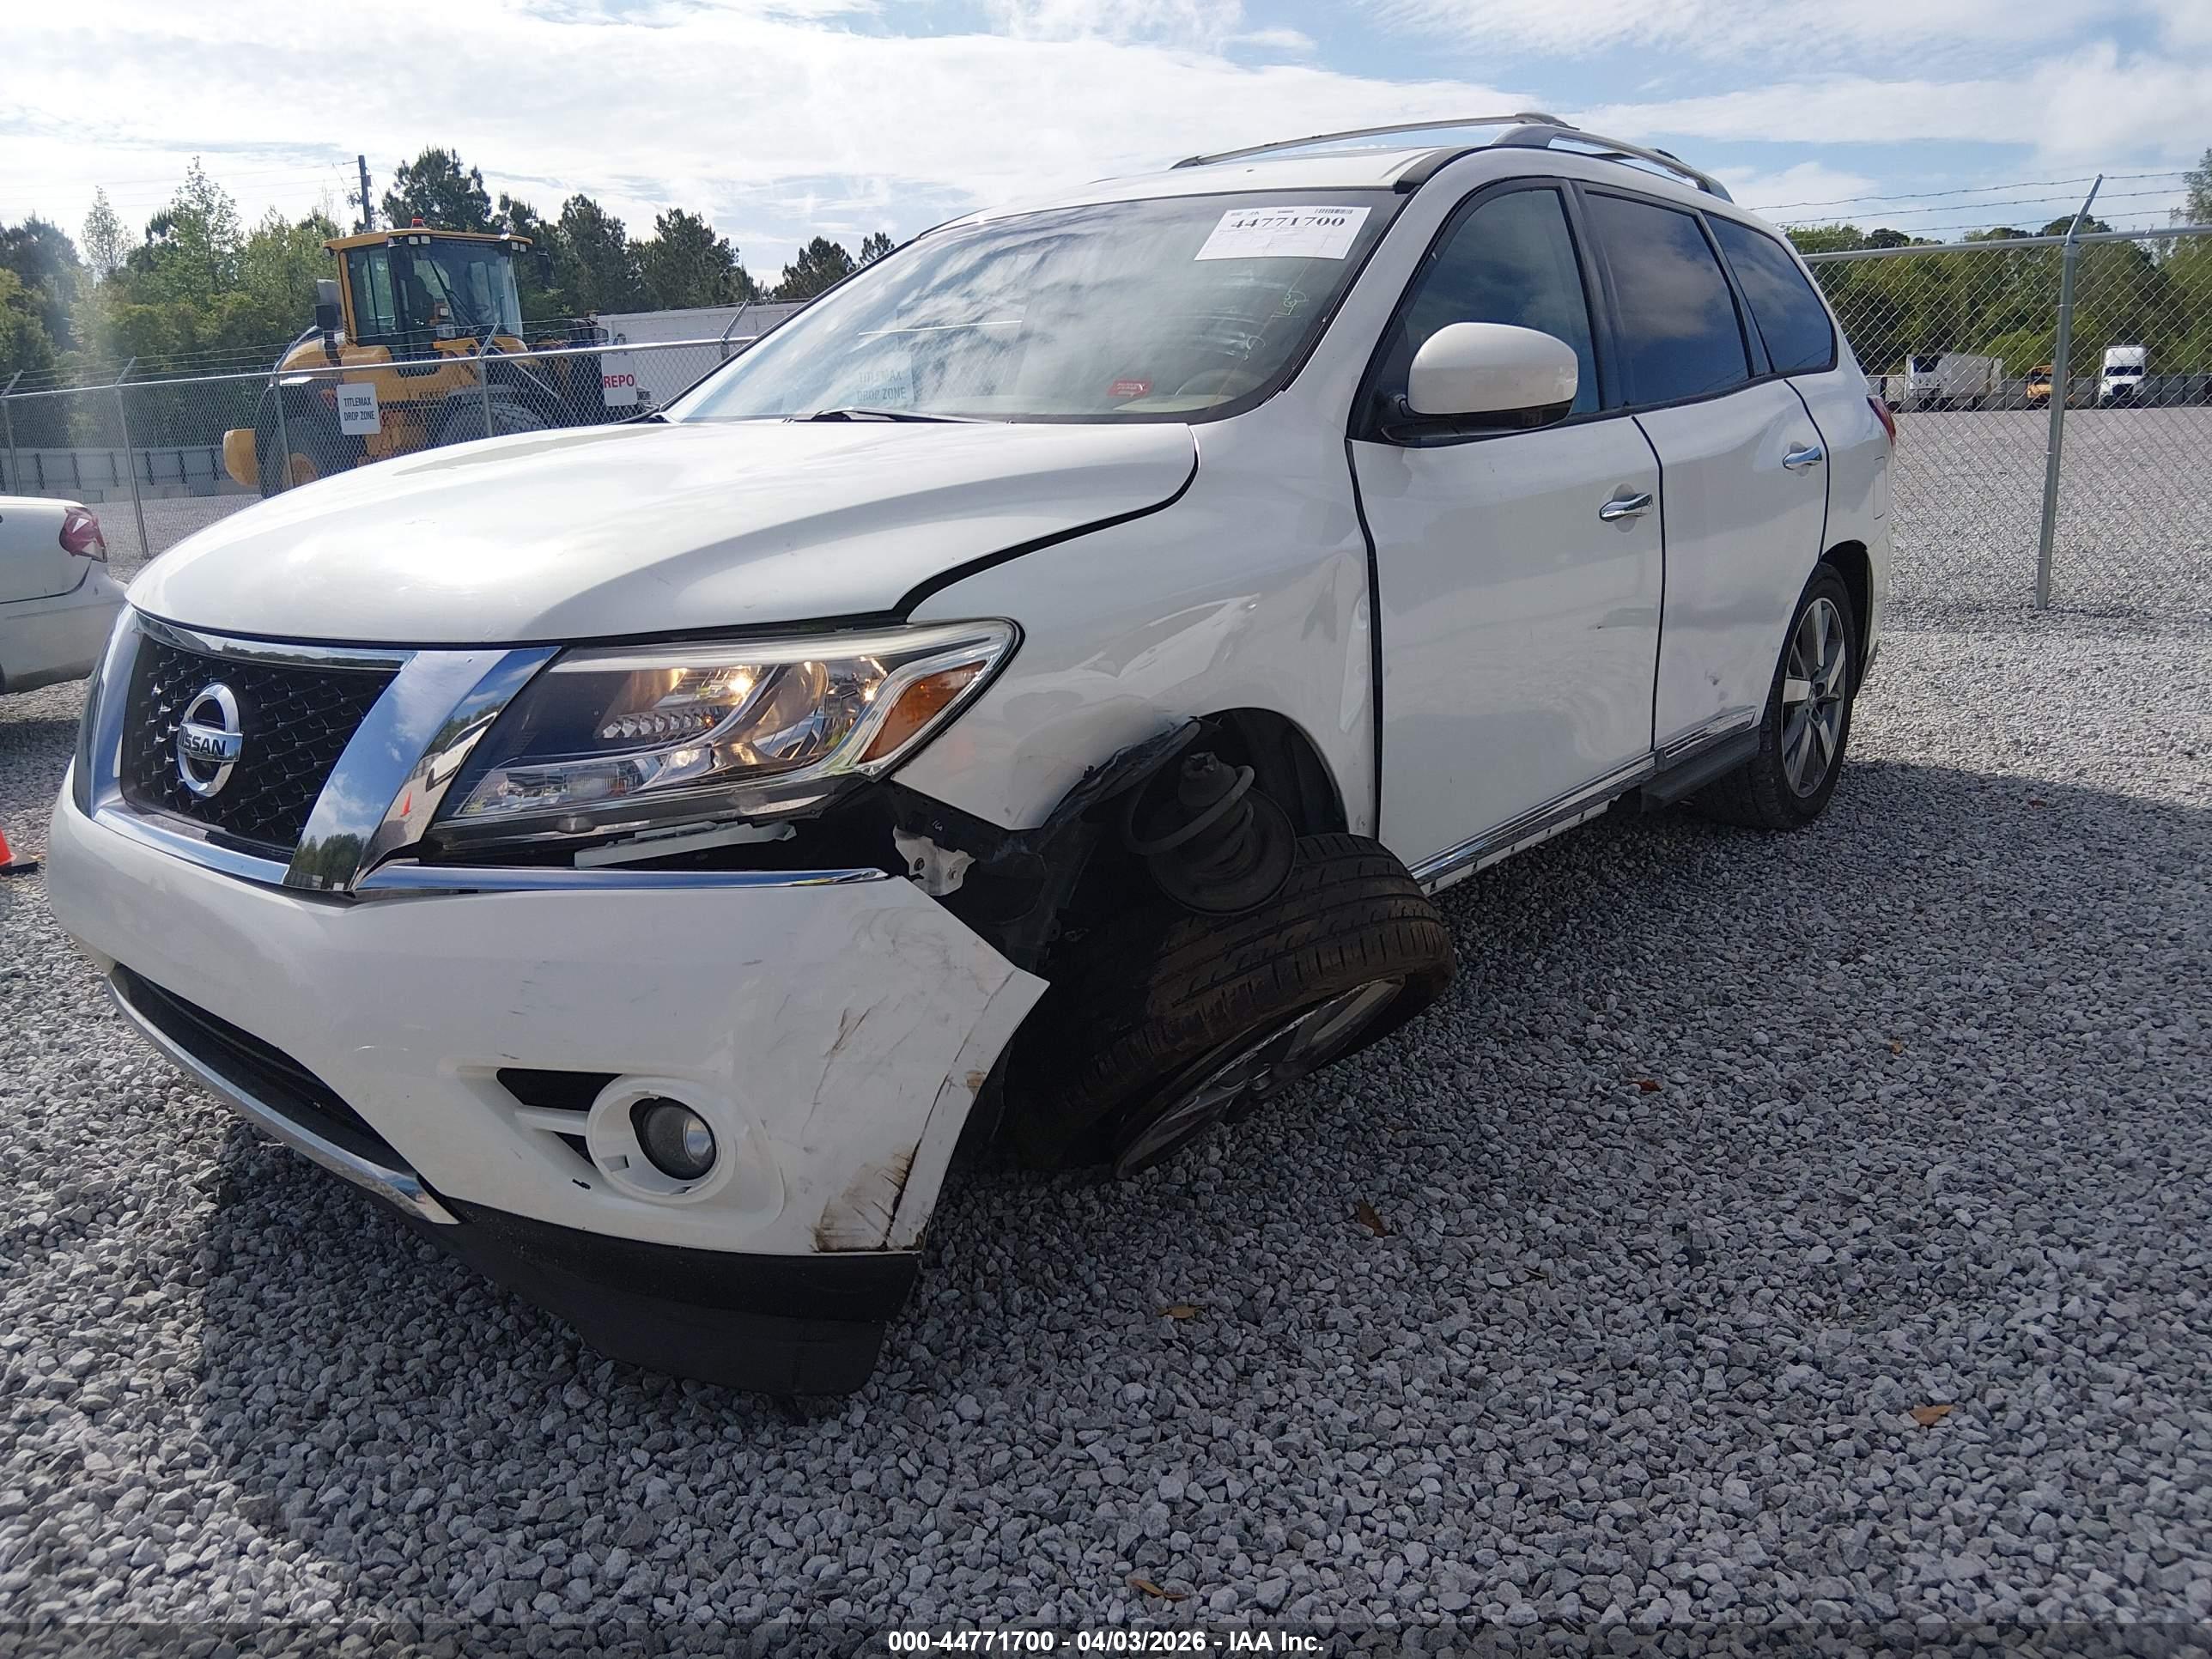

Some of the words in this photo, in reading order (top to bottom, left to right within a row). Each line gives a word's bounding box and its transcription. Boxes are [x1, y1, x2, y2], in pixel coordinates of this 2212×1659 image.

[1231, 216, 1346, 229] 44771700
[603, 374, 635, 389] REPO
[857, 390, 881, 402] DROP
[882, 386, 907, 400] ZONE
[343, 397, 372, 407] TITLEMAX
[343, 412, 359, 422] DROP
[360, 410, 375, 420] ZONE
[178, 725, 227, 756] NISSAN
